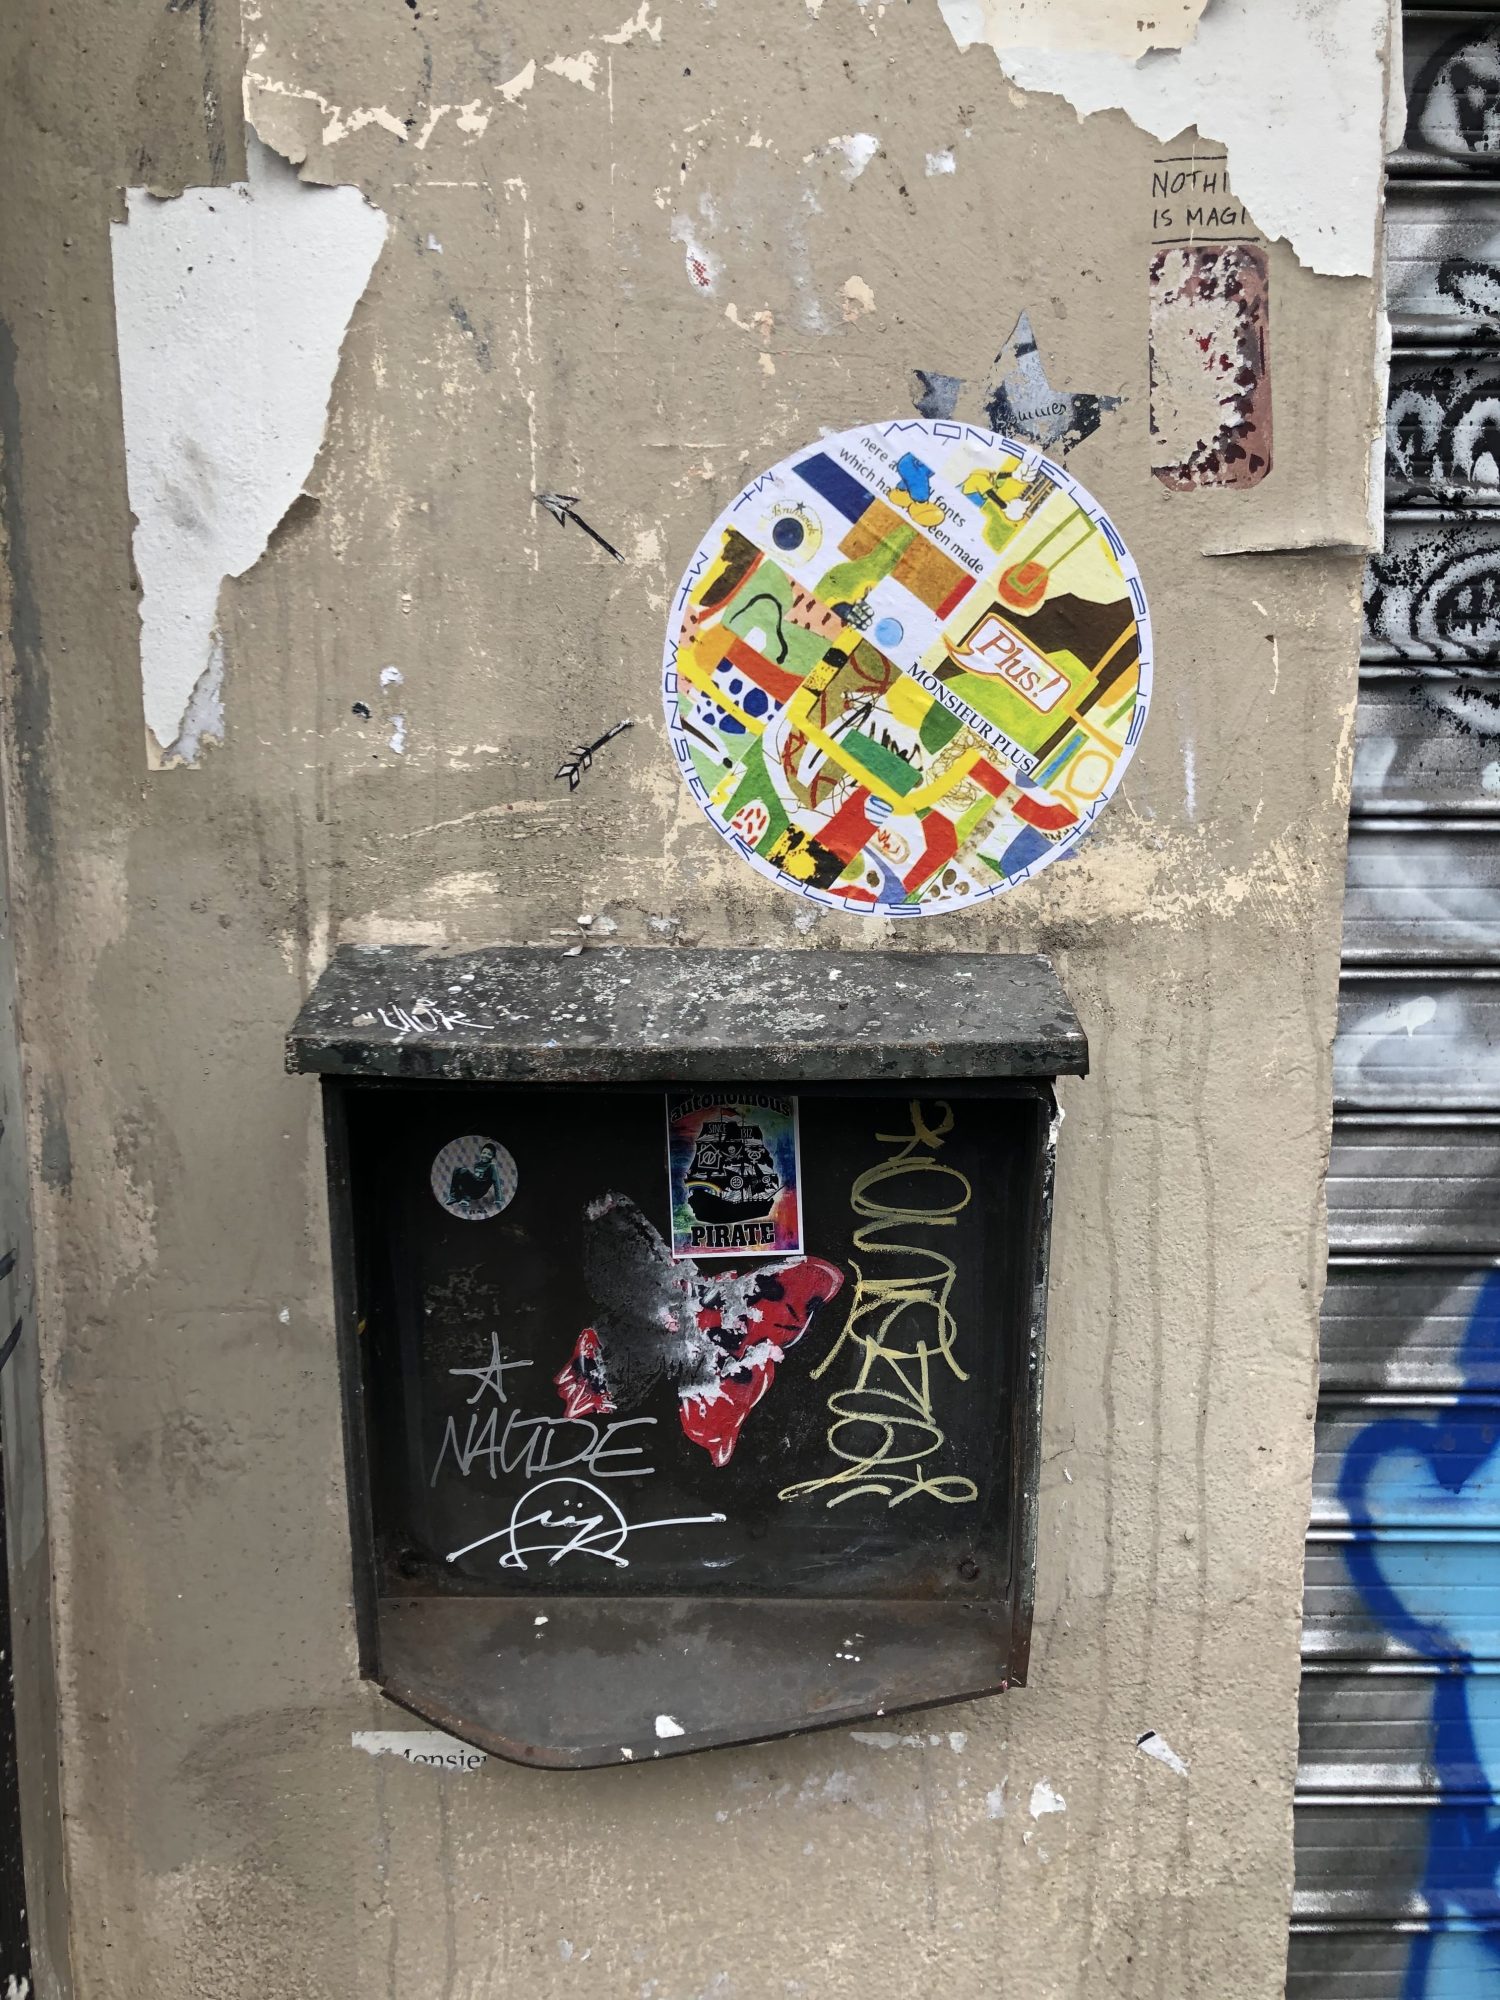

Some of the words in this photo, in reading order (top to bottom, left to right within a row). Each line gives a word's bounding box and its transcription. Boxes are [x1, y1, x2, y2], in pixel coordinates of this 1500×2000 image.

[1153, 208, 1173, 229] IS
[839, 447, 876, 483] which
[950, 542, 984, 575] made
[883, 423, 1126, 561] MONSIEUR
[932, 495, 966, 528] fonts
[975, 630, 1062, 699] Plus!
[906, 661, 993, 740] MONSIEUR
[991, 733, 1035, 773] PLUS
[690, 1222, 776, 1248] PIRATE
